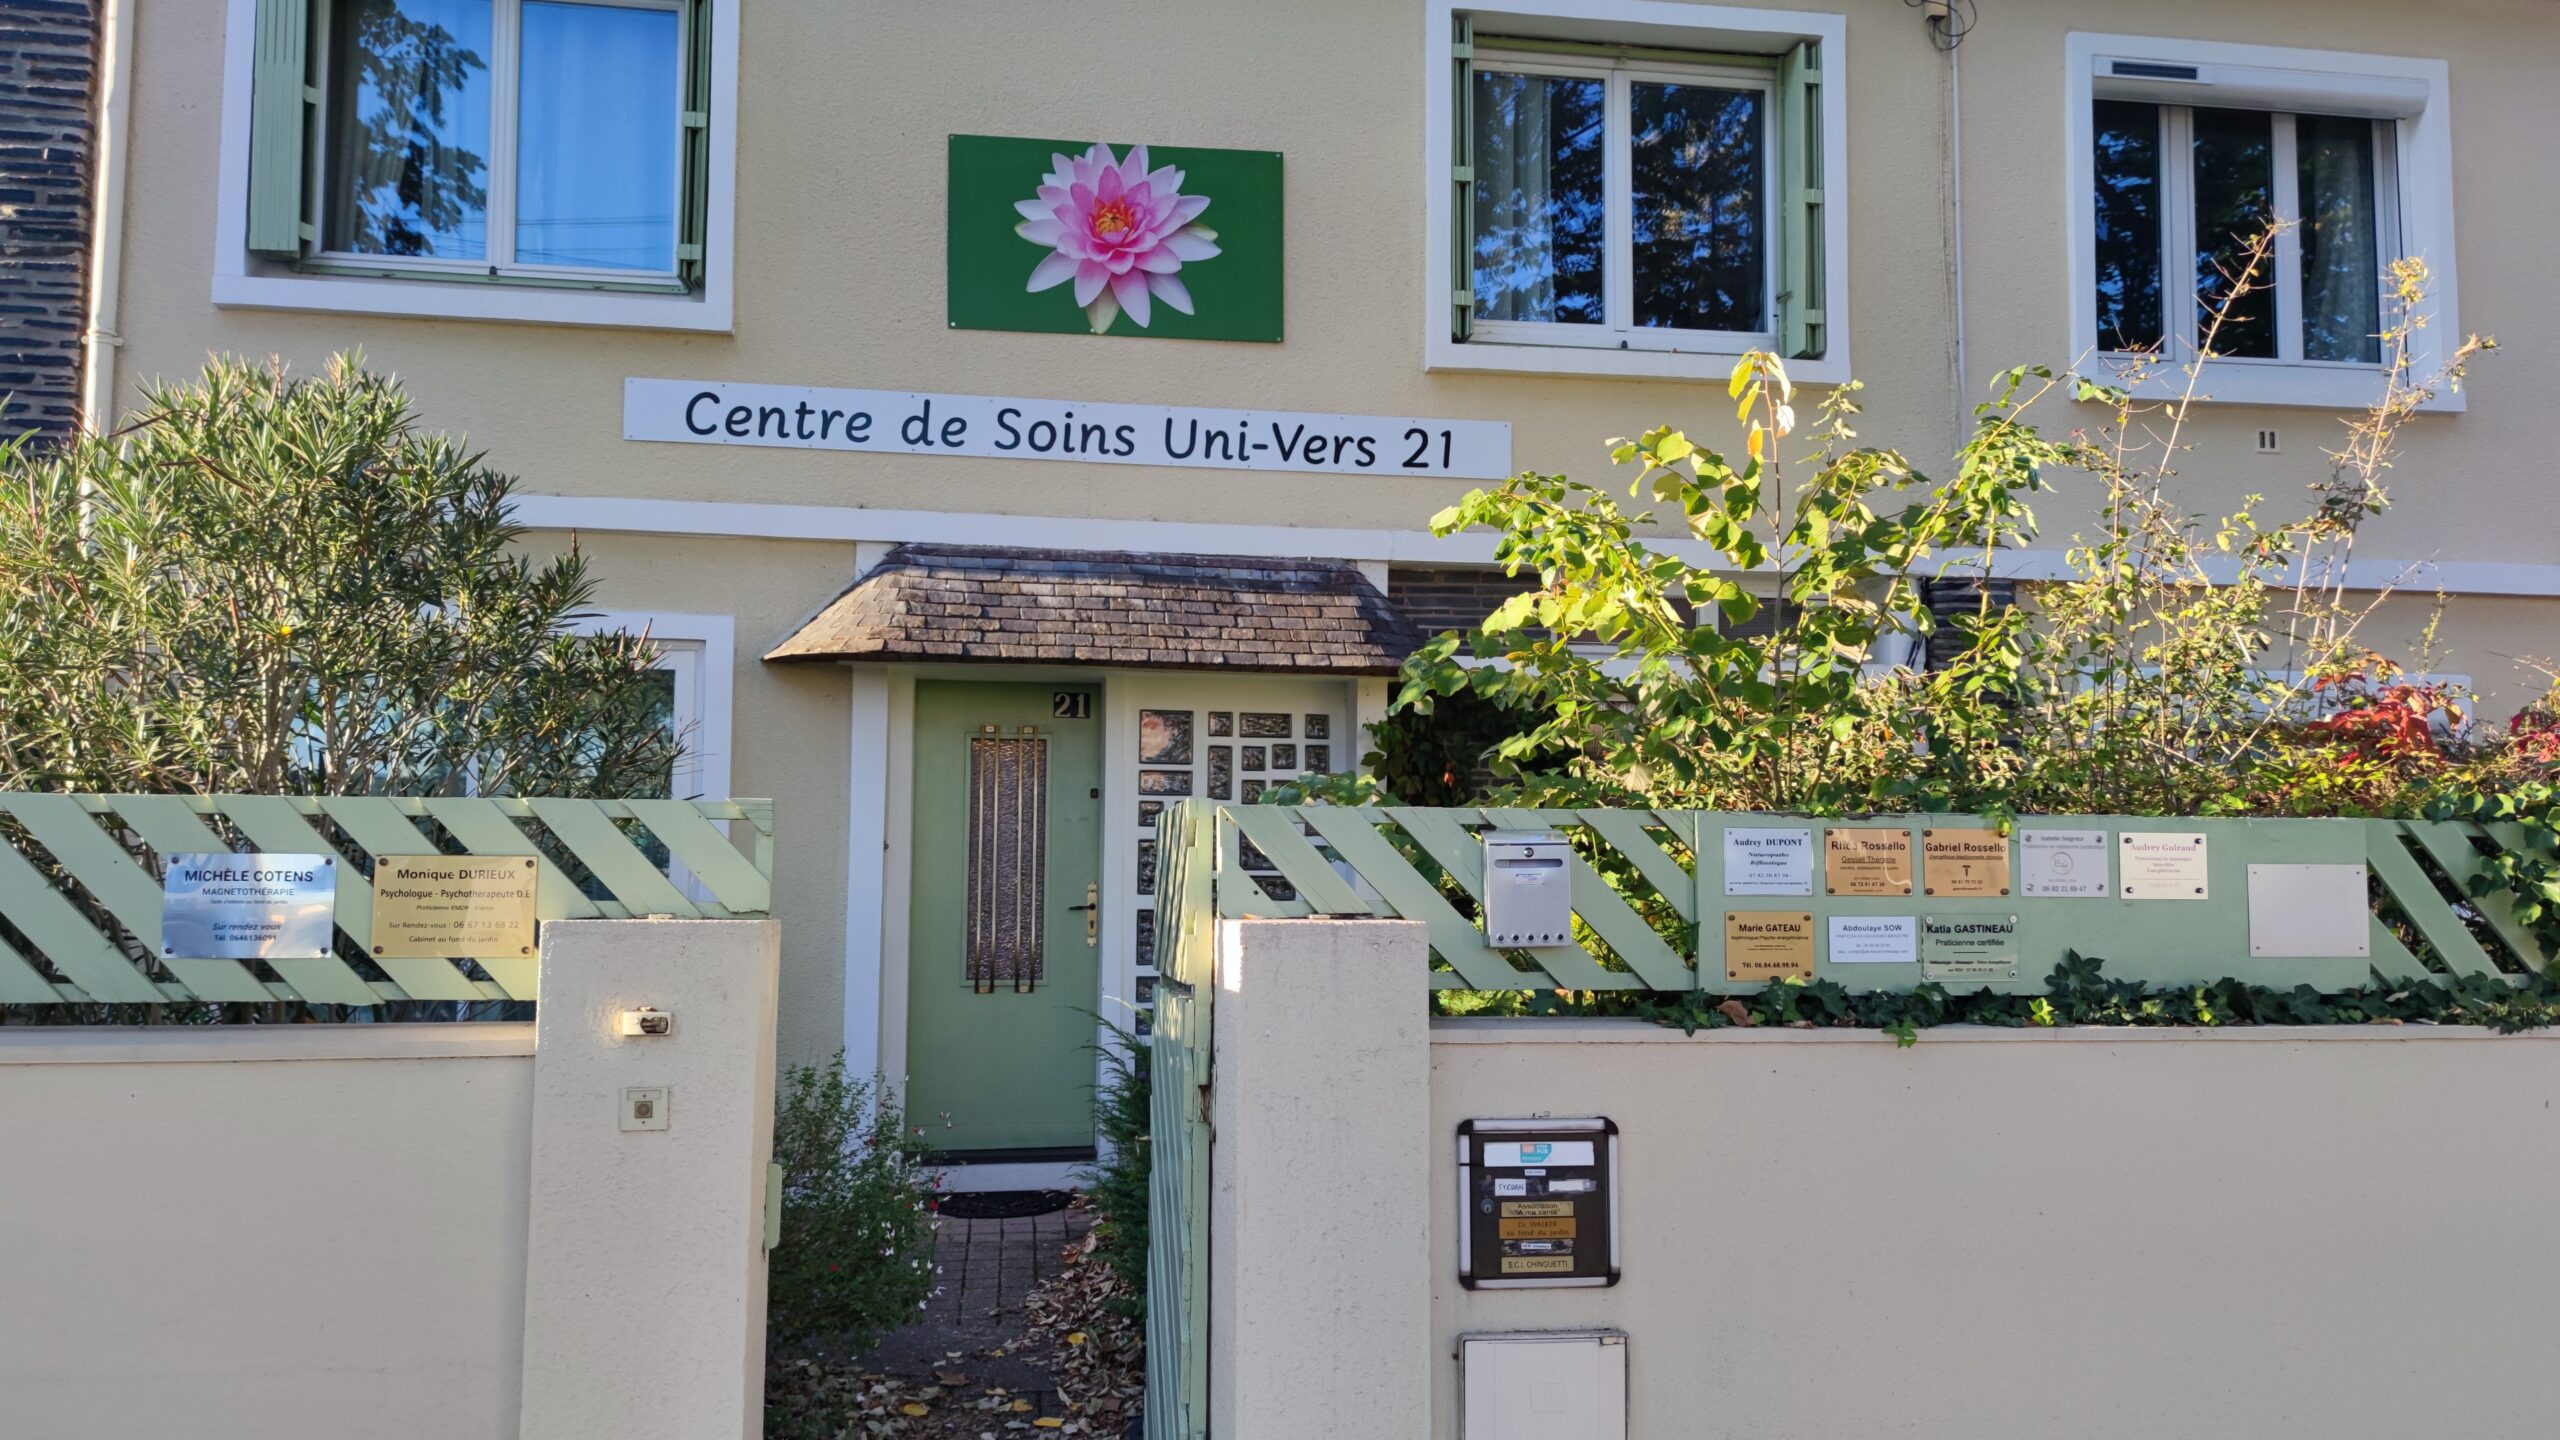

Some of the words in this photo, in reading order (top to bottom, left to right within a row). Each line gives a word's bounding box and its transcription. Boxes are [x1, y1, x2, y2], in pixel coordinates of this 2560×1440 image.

[685, 391, 873, 443] Centre
[901, 398, 968, 448] de
[994, 407, 1136, 457] Soins
[1164, 416, 1377, 469] Uni-Vers
[1402, 427, 1453, 469] 21
[1054, 692, 1087, 718] 21
[1734, 838, 1761, 847] Audrey
[1766, 838, 1803, 847] DUPONT
[1861, 841, 1905, 851] Rossello
[1926, 843, 1961, 852] Gabriel
[1964, 843, 2006, 852] Rossello
[2130, 843, 2160, 852] Audrey
[2162, 843, 2196, 852] Guiraud
[184, 867, 249, 882] MICHÈLE
[253, 870, 314, 882] COTENS
[397, 868, 455, 882] Monique
[459, 869, 516, 880] DURIEUX
[380, 888, 433, 899] Psychologue
[212, 922, 227, 931] Sur
[228, 922, 258, 931] rendez
[453, 920, 465, 929] 06
[467, 920, 479, 929] 67
[482, 920, 492, 929] 13
[508, 920, 519, 929] 22
[1739, 923, 1763, 932] Marie
[1765, 923, 1801, 932] GATEAU
[1842, 924, 1882, 932] Abdoulaye
[1926, 924, 1951, 933] Katia
[1954, 924, 2013, 933] GASTINEAU
[408, 935, 436, 943] Cabinet
[1526, 1260, 1567, 1268] CHINGUETTI
